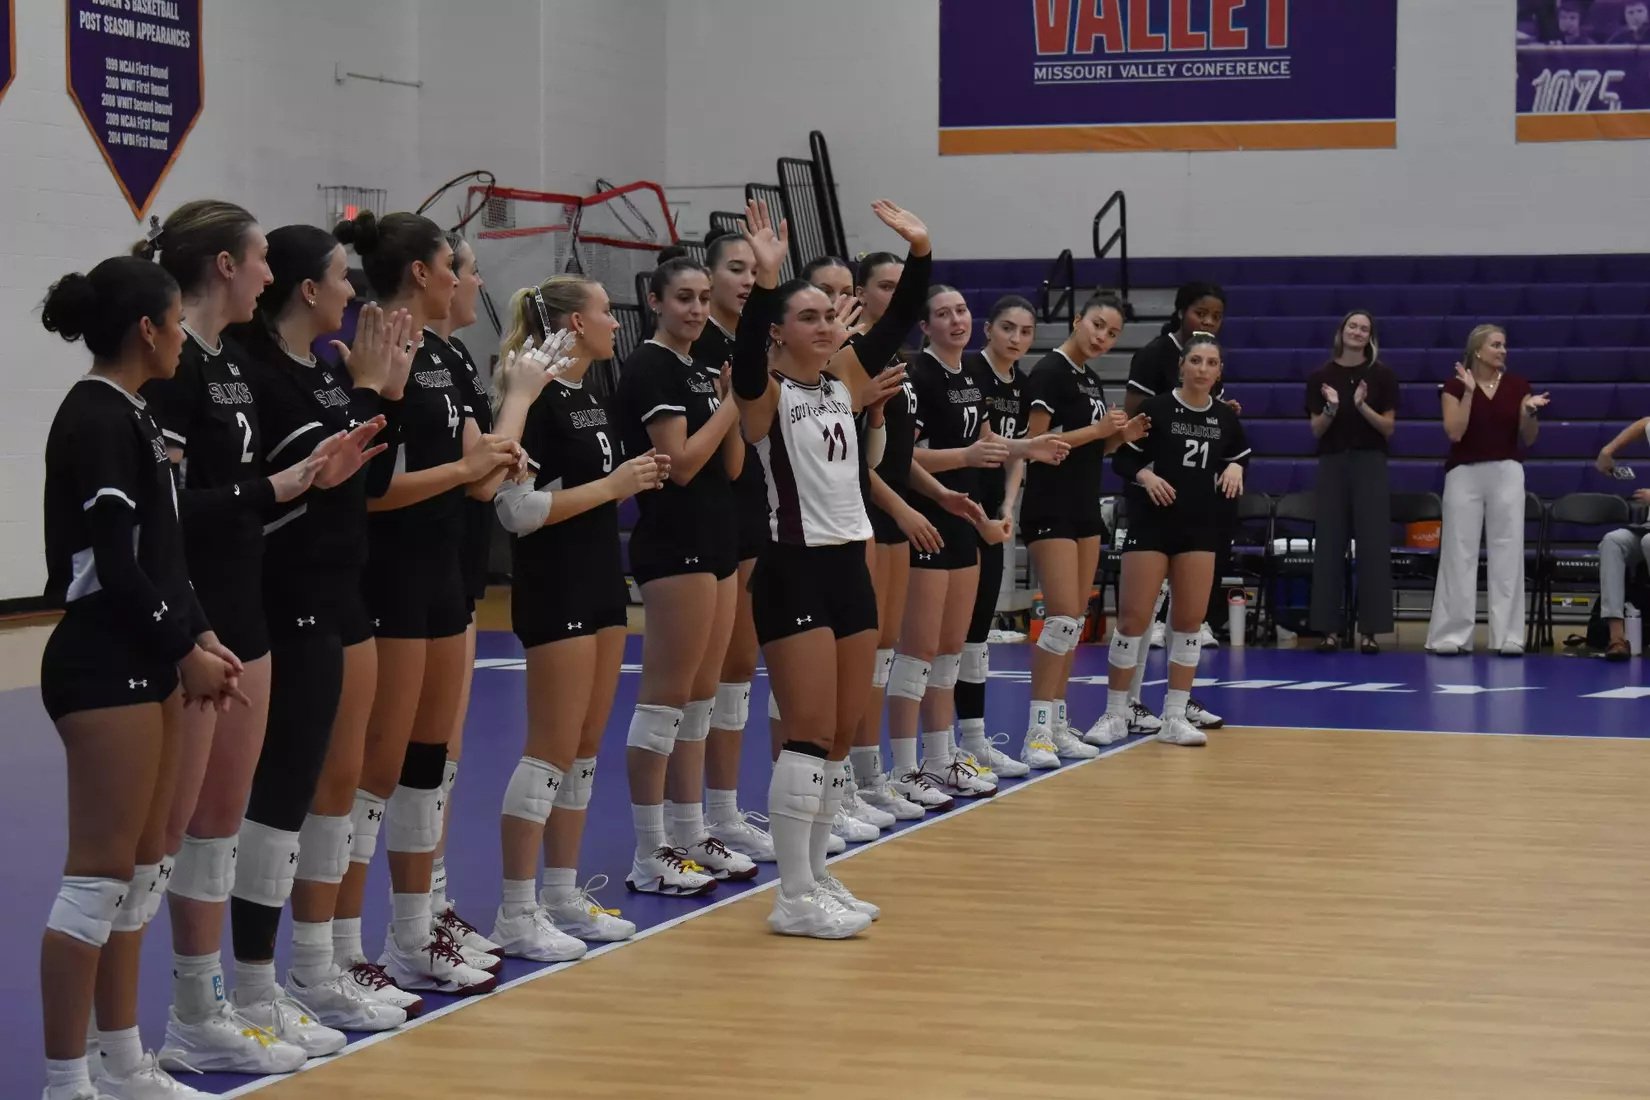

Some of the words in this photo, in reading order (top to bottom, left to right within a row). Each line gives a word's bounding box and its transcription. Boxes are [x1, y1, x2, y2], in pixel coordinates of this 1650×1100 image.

[132, 0, 180, 20] BASKETBALL
[79, 10, 101, 32] POST
[103, 15, 135, 38] SEASON
[136, 21, 191, 49] APPEARANCES
[119, 59, 135, 74] NCAA
[135, 61, 149, 77] First
[150, 64, 169, 80] Round
[1034, 66, 1112, 80] MISSOURI
[1120, 64, 1177, 78] VALLEY
[1182, 61, 1290, 76] CONFERENCE
[136, 79, 150, 95] First
[150, 82, 169, 98] Round
[116, 95, 133, 110] WNIT
[133, 97, 154, 113] Second
[154, 100, 173, 116] Round
[120, 113, 137, 129] NCAA
[137, 115, 151, 131] First
[151, 118, 170, 133] Round
[135, 133, 149, 149] First
[149, 136, 168, 151] Round
[902, 381, 918, 414] 15
[444, 393, 460, 439] 4
[963, 406, 978, 438] 17
[235, 411, 254, 463] 2
[999, 416, 1017, 440] 18
[1171, 421, 1222, 440] SALUKIS
[595, 431, 613, 473] 9
[822, 422, 847, 462] 11
[1182, 439, 1210, 469] 21
[1555, 560, 1601, 568] EVANSVILLE
[1035, 605, 1046, 617] G
